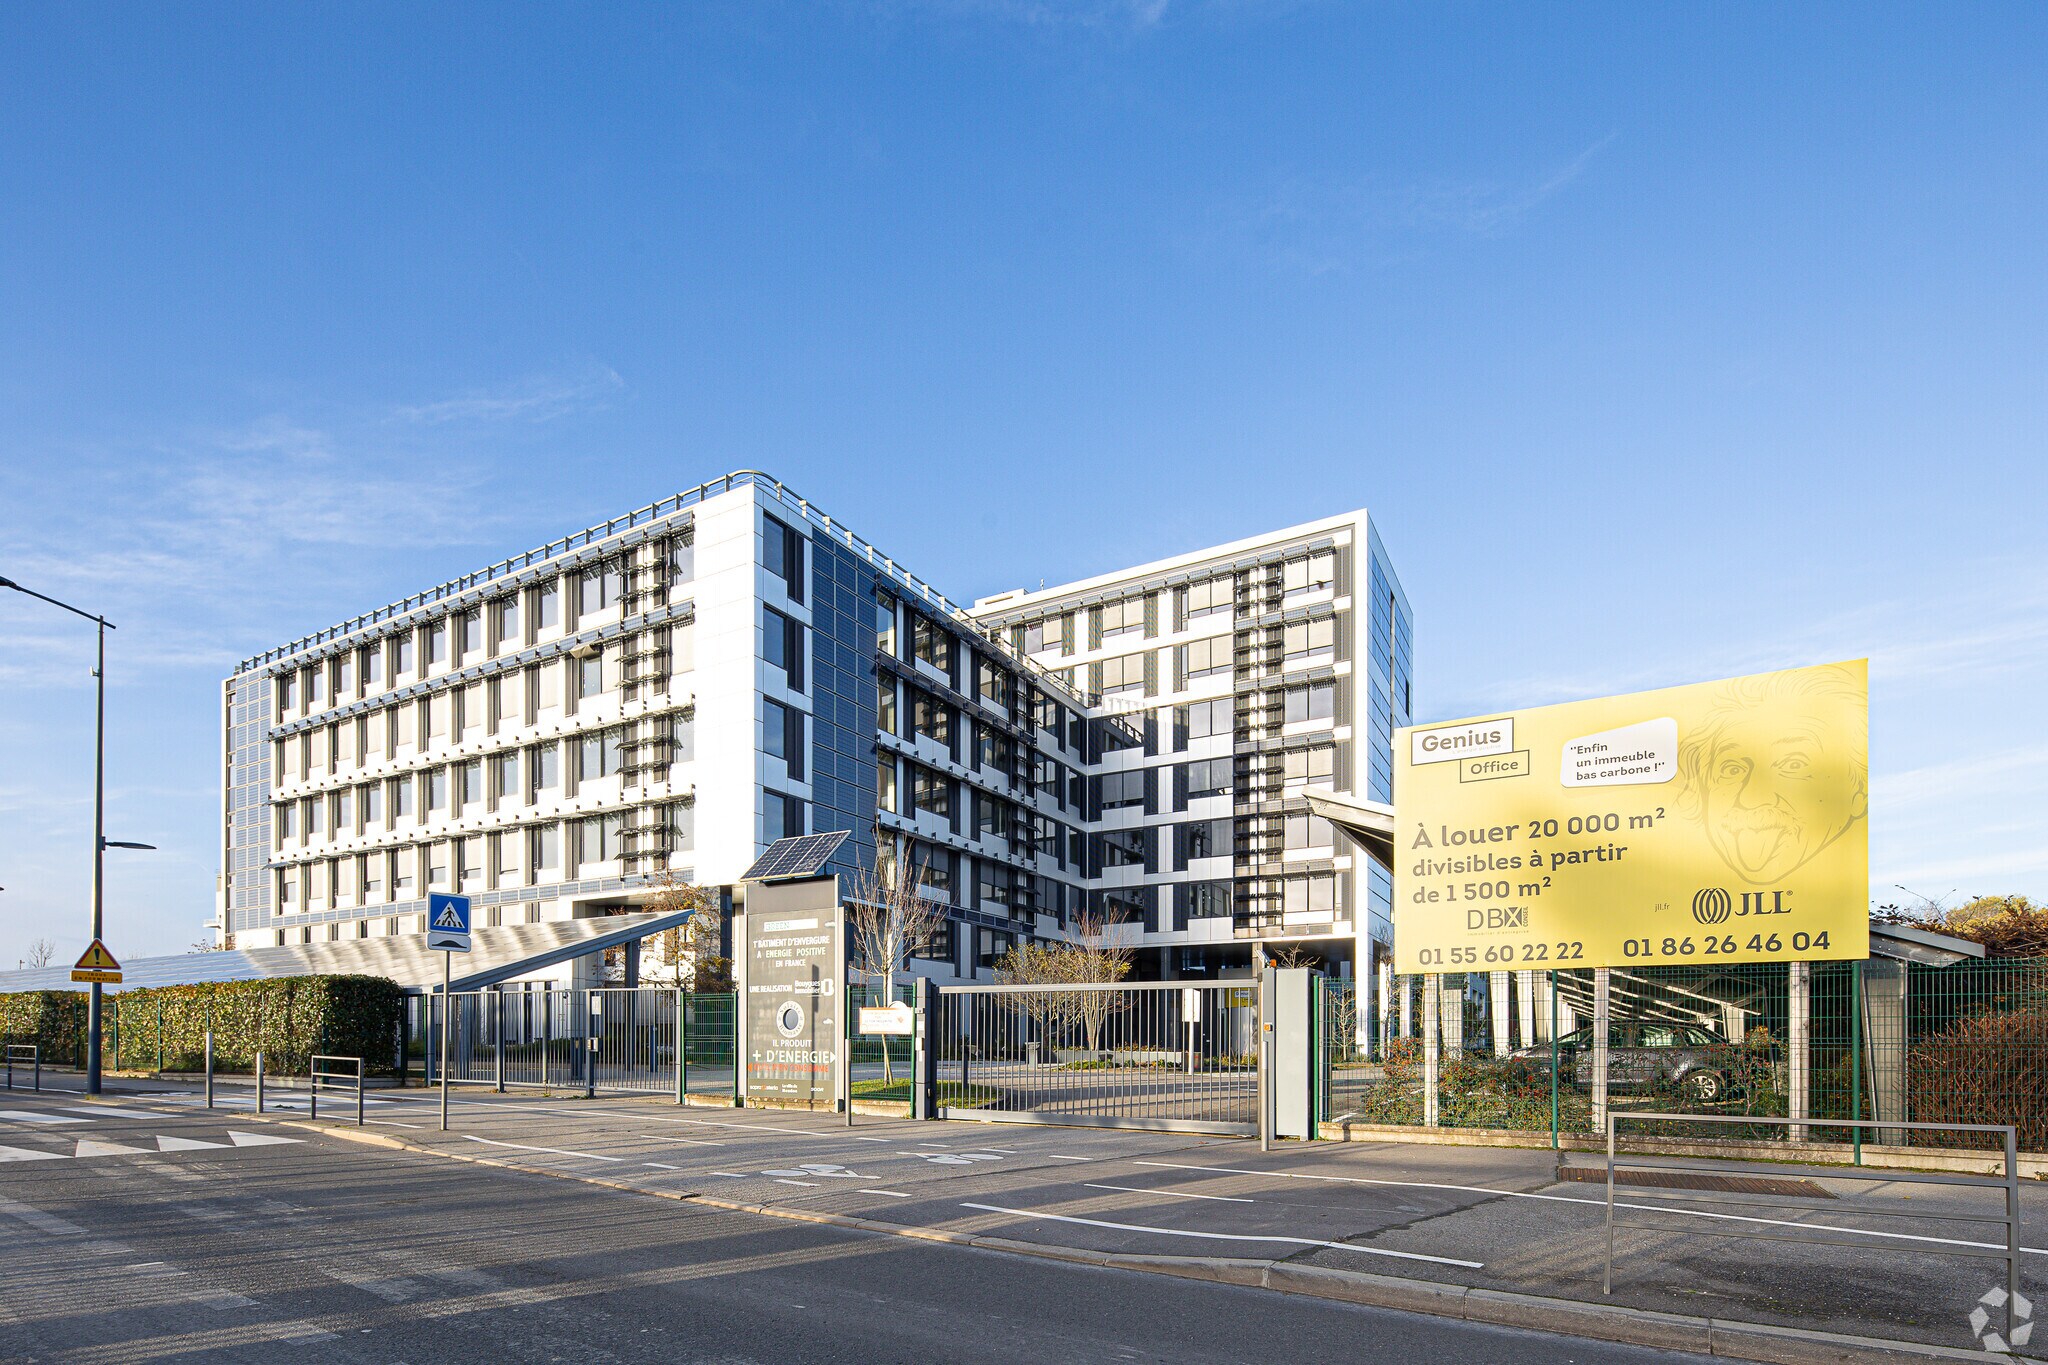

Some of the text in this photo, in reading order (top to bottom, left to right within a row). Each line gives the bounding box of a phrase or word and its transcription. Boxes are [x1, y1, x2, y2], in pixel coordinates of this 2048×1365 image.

[1422, 730, 1501, 752] Genius
[1470, 761, 1519, 775] Office
[1576, 750, 1656, 768] un immeuble
[1576, 771, 1597, 781] bas
[1600, 765, 1651, 778] carbone
[1411, 822, 1433, 850] À
[1441, 824, 1520, 847] louer
[1528, 819, 1559, 839] 20
[1567, 812, 1620, 835] 000
[1412, 843, 1628, 877] divisibles à partir
[1412, 886, 1440, 904] de
[1467, 906, 1523, 930] DBX
[766, 948, 792, 958] ENERGIE
[796, 947, 826, 957] POSITIVE
[1623, 930, 1830, 957] 01 86 26 46 04
[1419, 941, 1584, 966] 01 55 60 22 22
[785, 959, 806, 967] FRANCE
[794, 980, 820, 988] Bouygues
[780, 1039, 812, 1048] PRODUIT
[766, 1049, 830, 1064] D'ENERGIE
